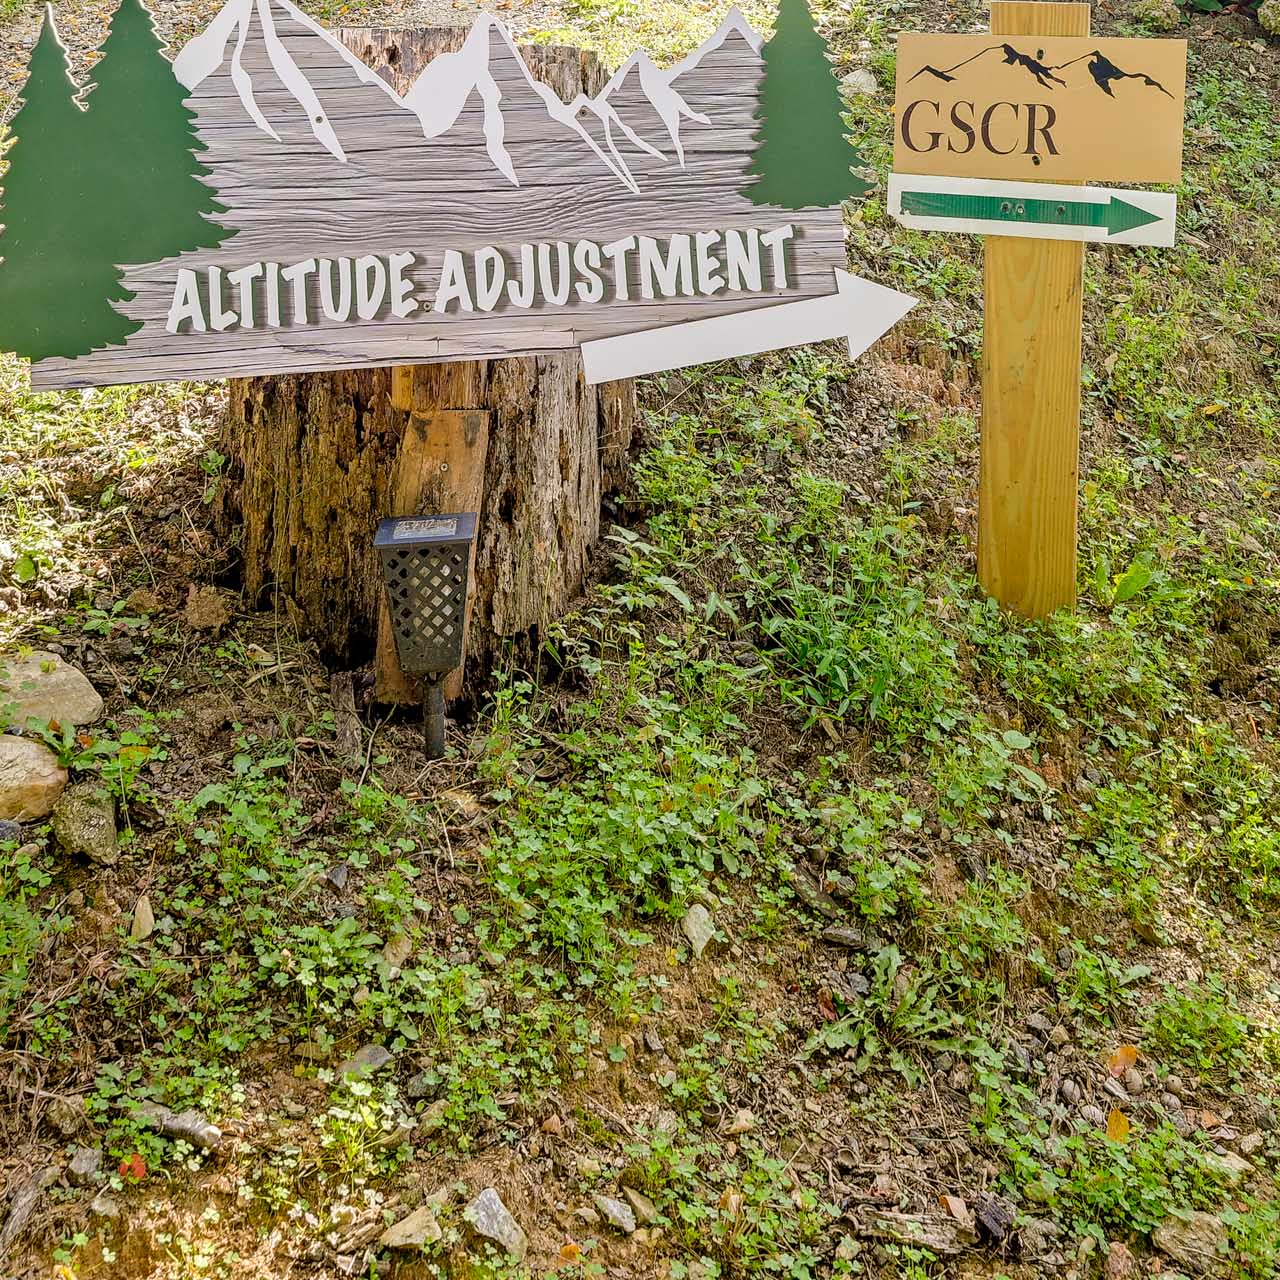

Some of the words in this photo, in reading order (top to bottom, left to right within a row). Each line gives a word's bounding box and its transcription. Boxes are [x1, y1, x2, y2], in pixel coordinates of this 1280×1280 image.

[901, 99, 1061, 156] GSCR
[166, 251, 422, 333] ALTITUDE
[434, 224, 796, 313] ADJUSTMENT
